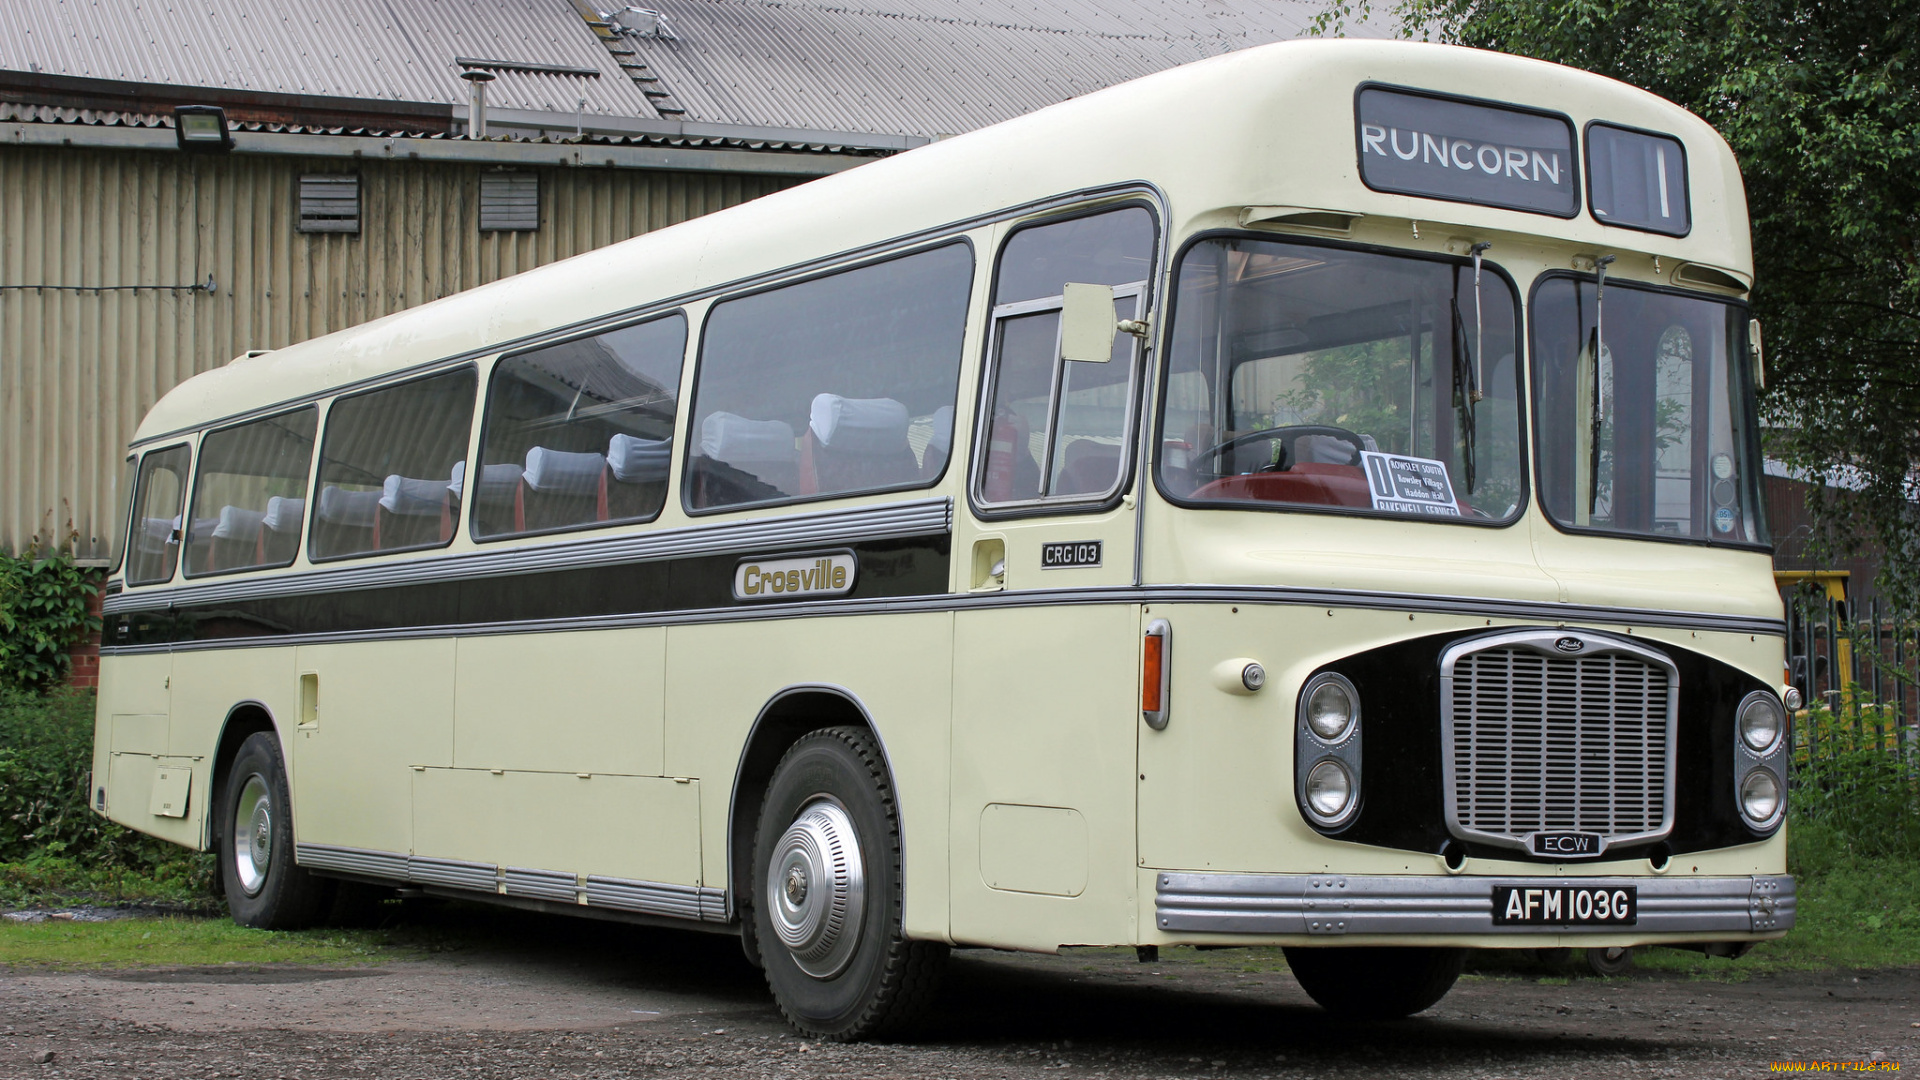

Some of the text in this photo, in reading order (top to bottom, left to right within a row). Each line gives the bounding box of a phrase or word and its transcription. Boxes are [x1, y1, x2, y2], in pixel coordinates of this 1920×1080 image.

[1362, 123, 1560, 185] RUNCORN
[1656, 144, 1670, 218] 1
[1391, 460, 1443, 476] ROWSLEY SOUTH
[1397, 474, 1444, 490] Rowsley Village
[1404, 488, 1445, 501] Haddon Hall
[744, 559, 846, 595] Crosville
[1544, 836, 1589, 852] ECW
